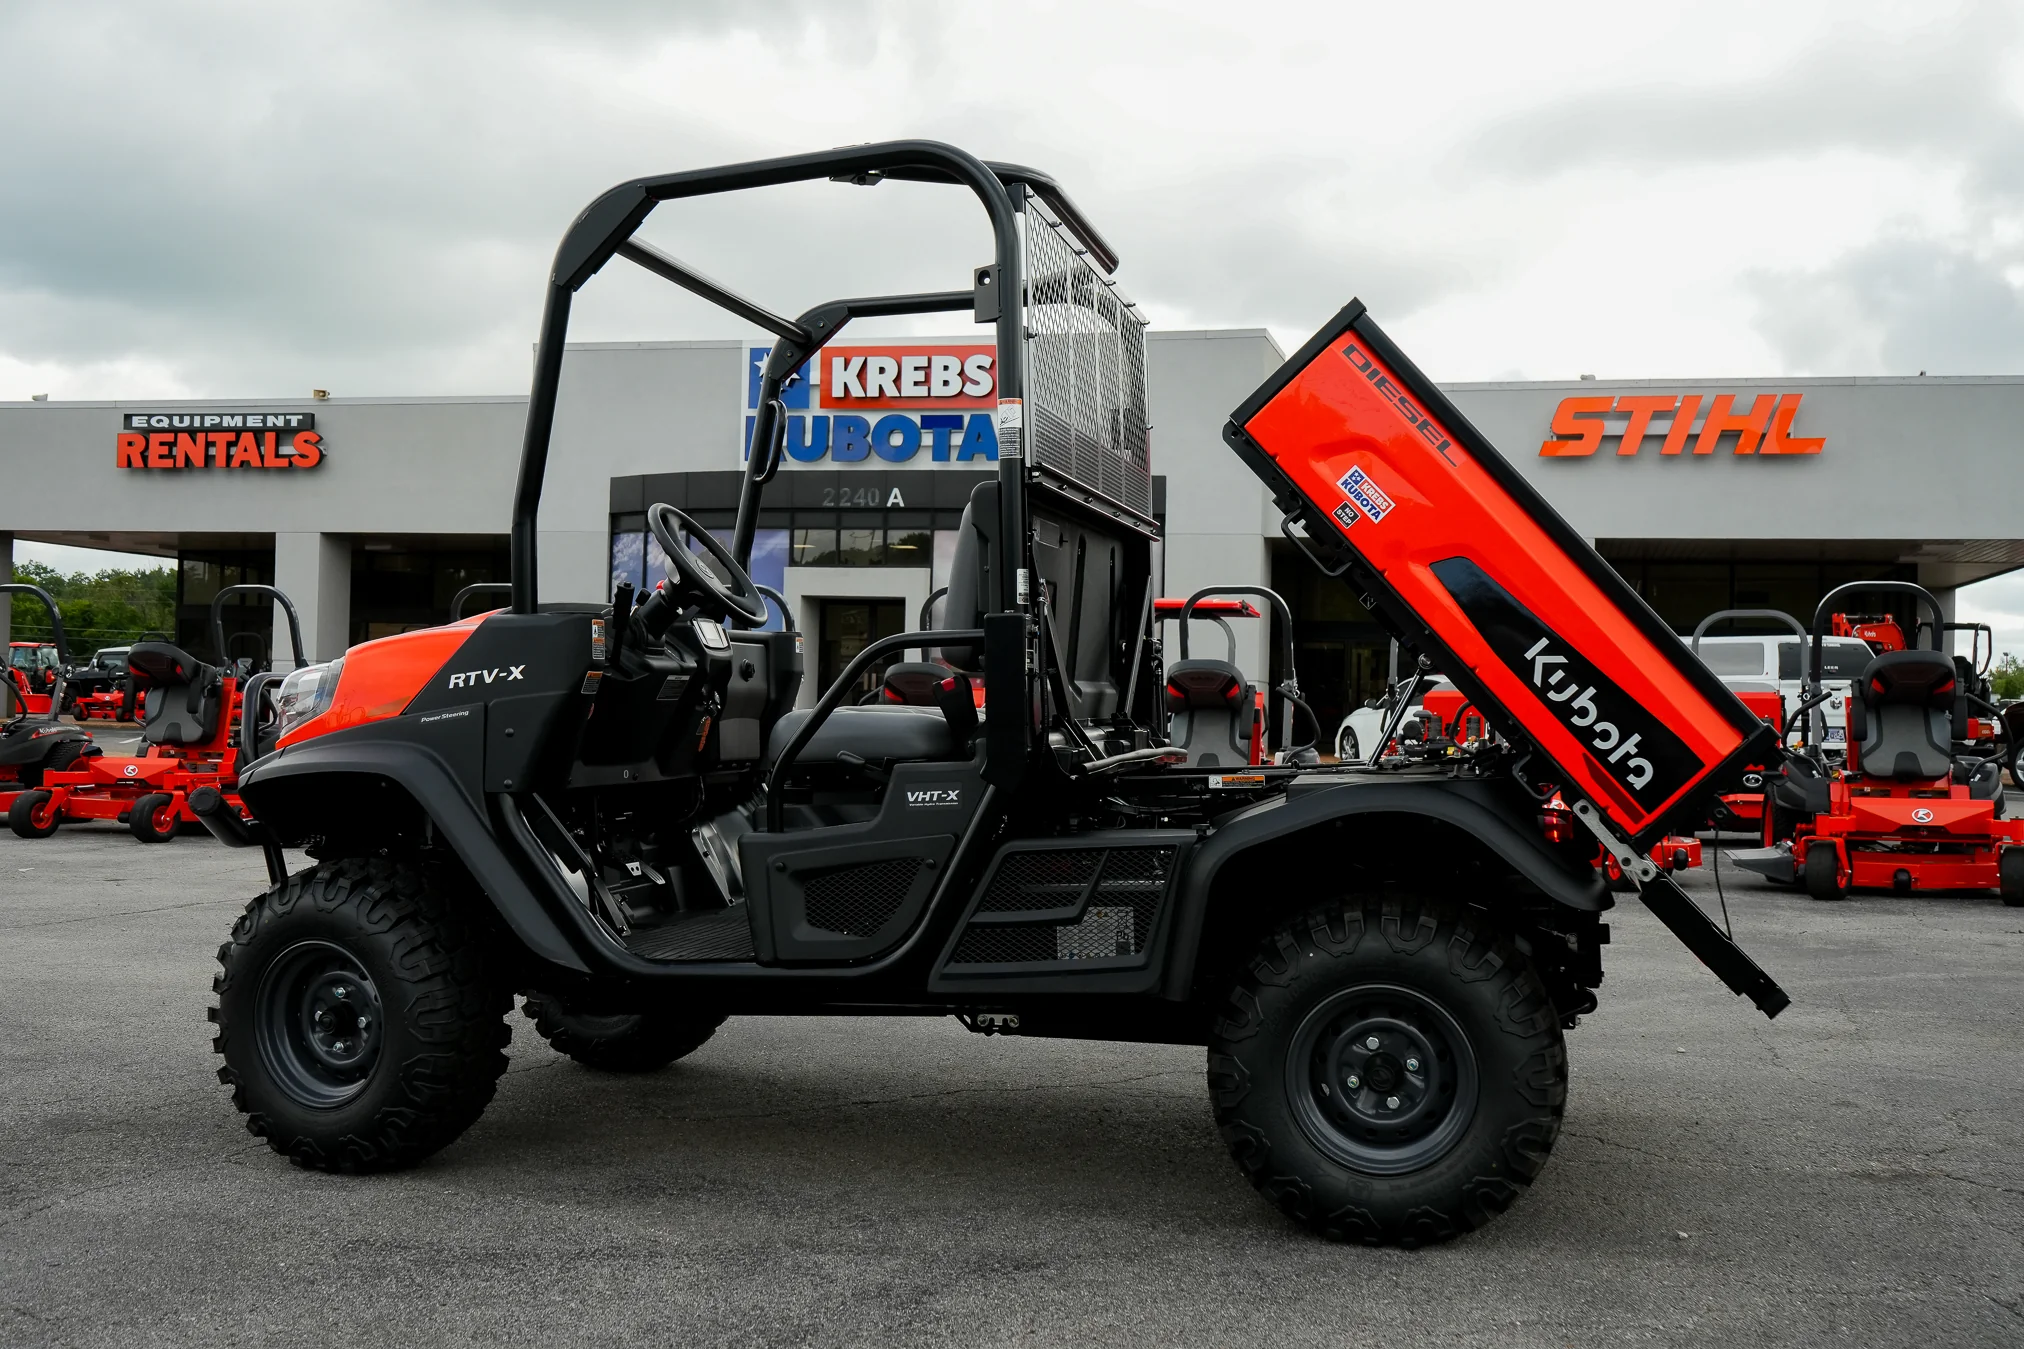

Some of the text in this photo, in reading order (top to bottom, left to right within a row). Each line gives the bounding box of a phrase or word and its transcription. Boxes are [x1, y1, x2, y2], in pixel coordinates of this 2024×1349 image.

[831, 353, 995, 399] KREBS
[1342, 343, 1457, 468] DIESEL
[131, 415, 303, 428] EQUIPMENT
[1538, 393, 1827, 457] STIHL
[116, 430, 323, 469] RENTALS
[822, 487, 905, 508] 2240 A
[1340, 478, 1382, 521] KUBOTA
[1360, 482, 1389, 510] KREBS
[1336, 508, 1352, 524] STEP
[1344, 507, 1355, 518] NO
[448, 664, 527, 689] RTV-X
[420, 710, 470, 723] Power Steering
[1523, 636, 1654, 791] Kubota
[906, 789, 960, 802] VHT-X
